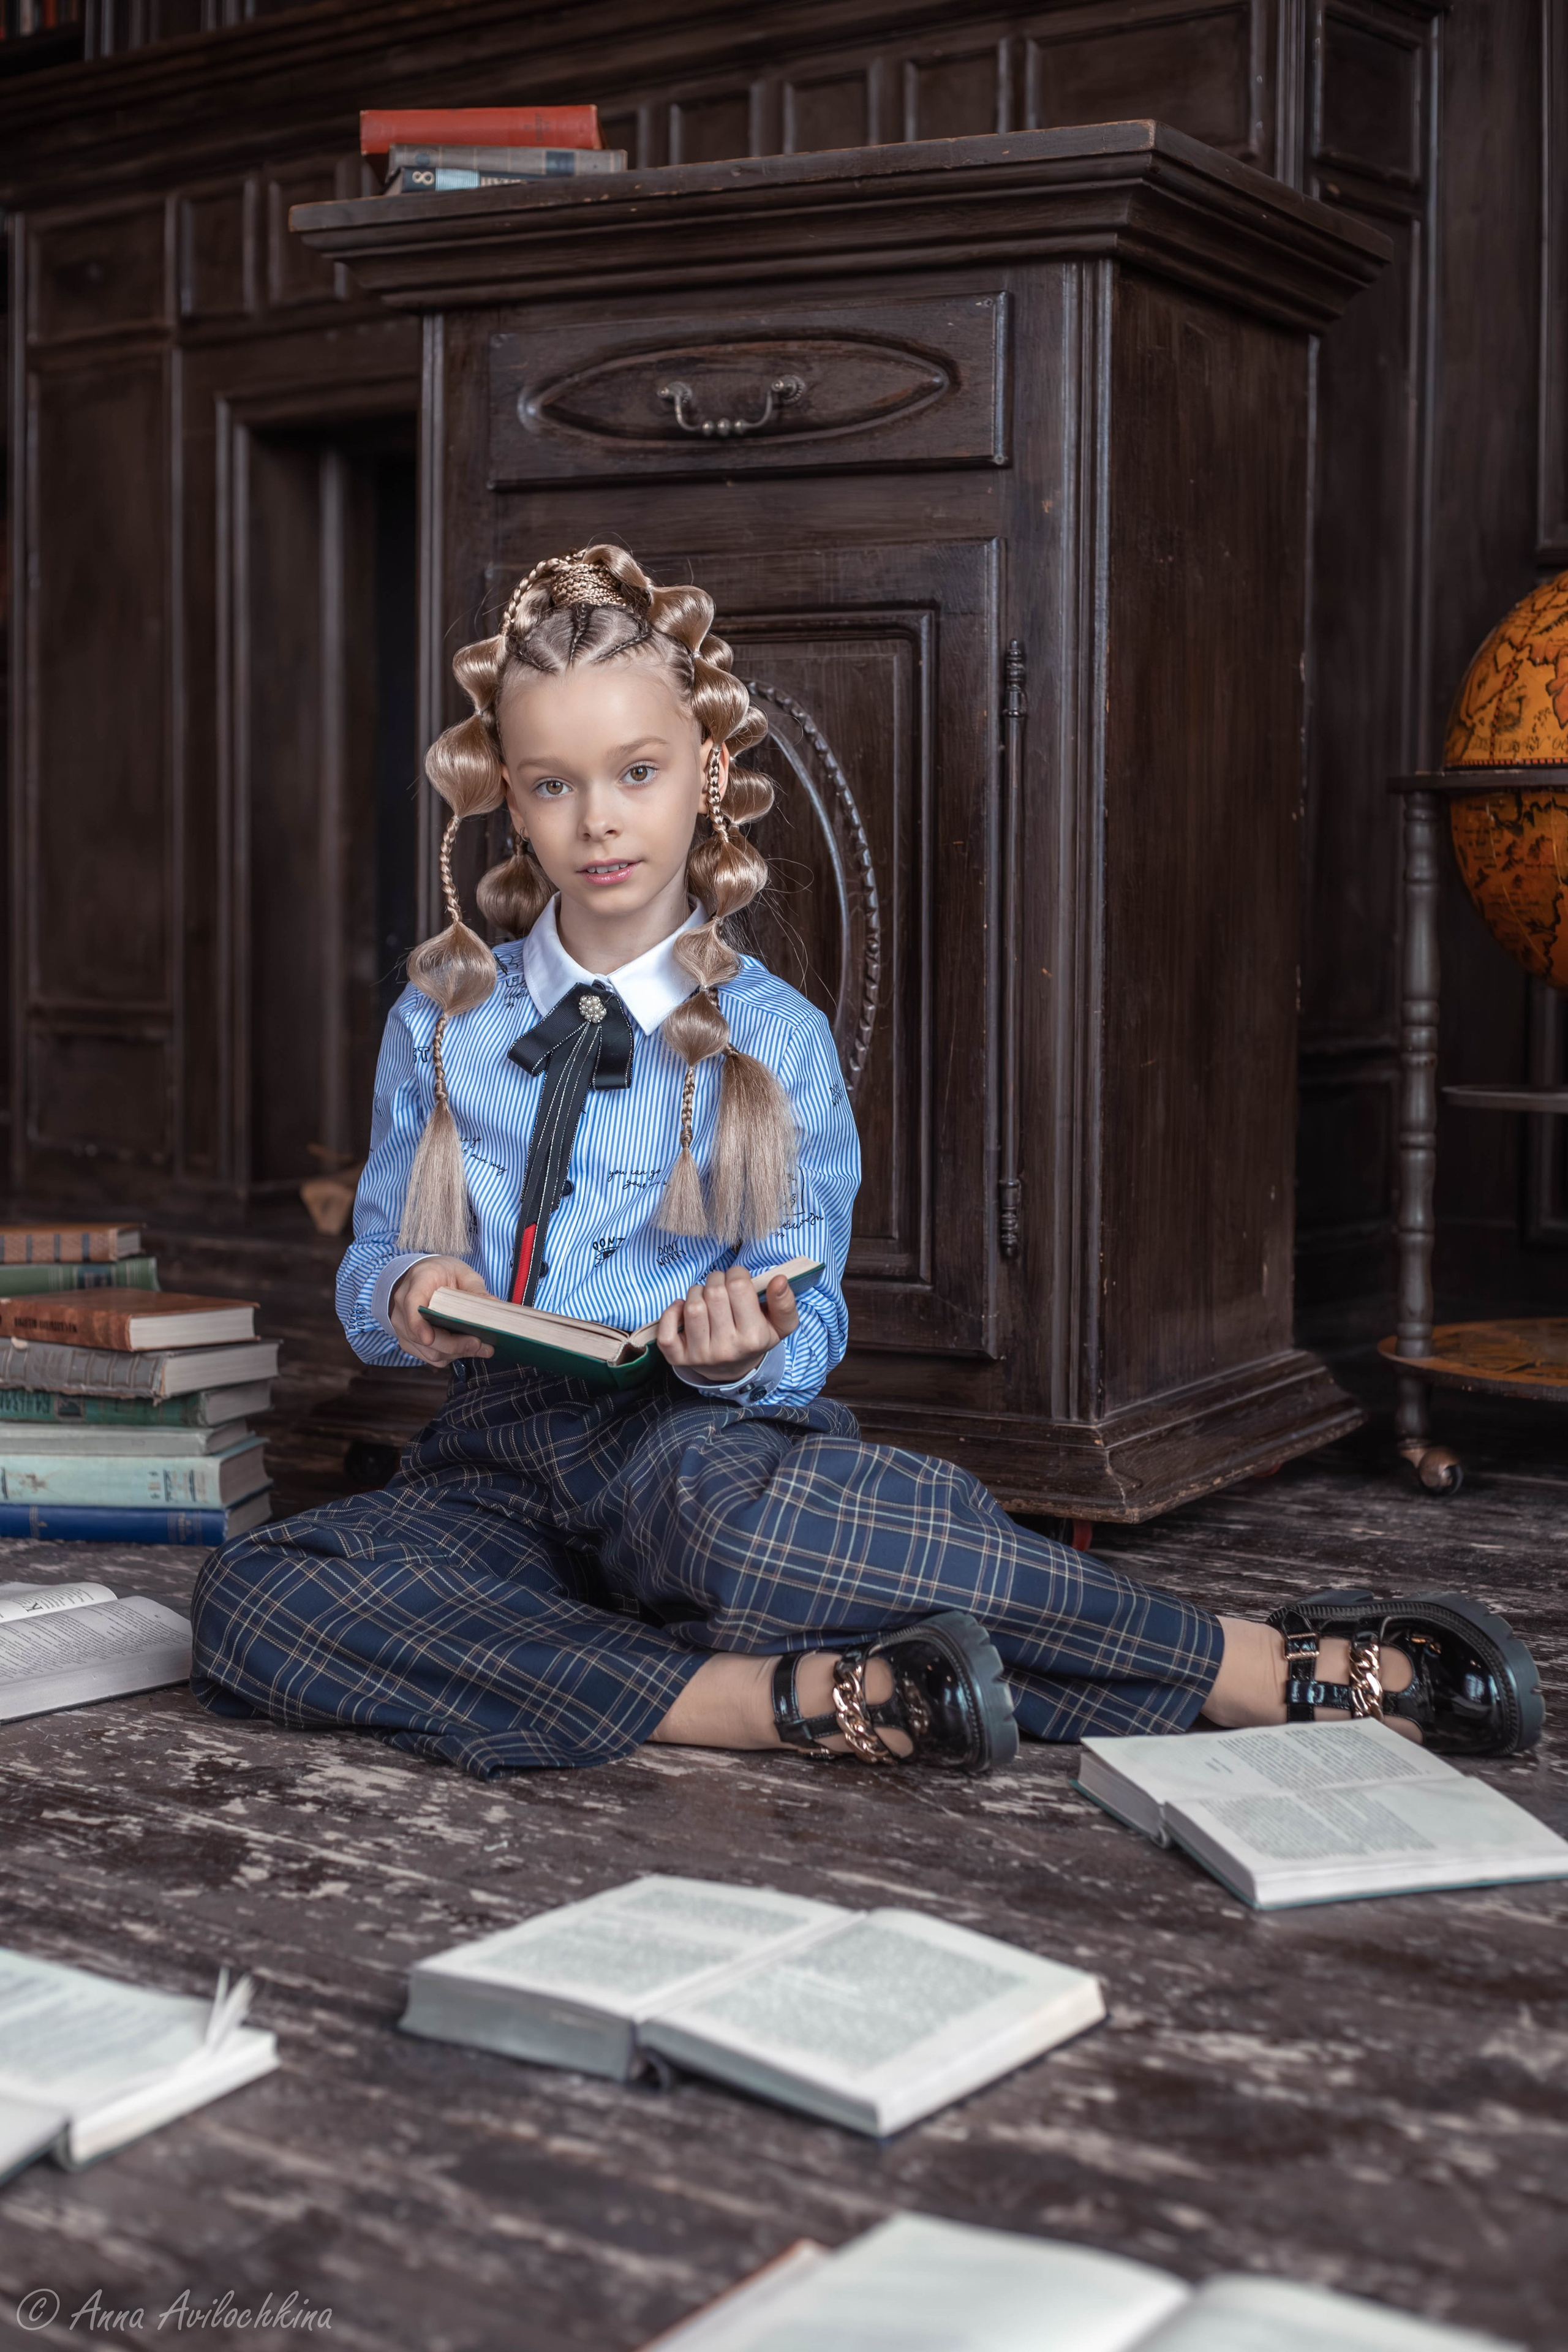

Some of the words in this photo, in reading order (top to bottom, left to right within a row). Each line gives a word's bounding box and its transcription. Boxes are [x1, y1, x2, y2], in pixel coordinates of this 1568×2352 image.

[491, 1161, 507, 1176] way
[607, 1170, 627, 1182] you
[648, 1169, 662, 1181] go
[622, 1180, 647, 1189] your
[592, 1237, 625, 1250] DONT
[658, 1240, 678, 1256] DONT
[656, 1248, 687, 1267] WORRY
[356, 1302, 366, 1334] WORRY
